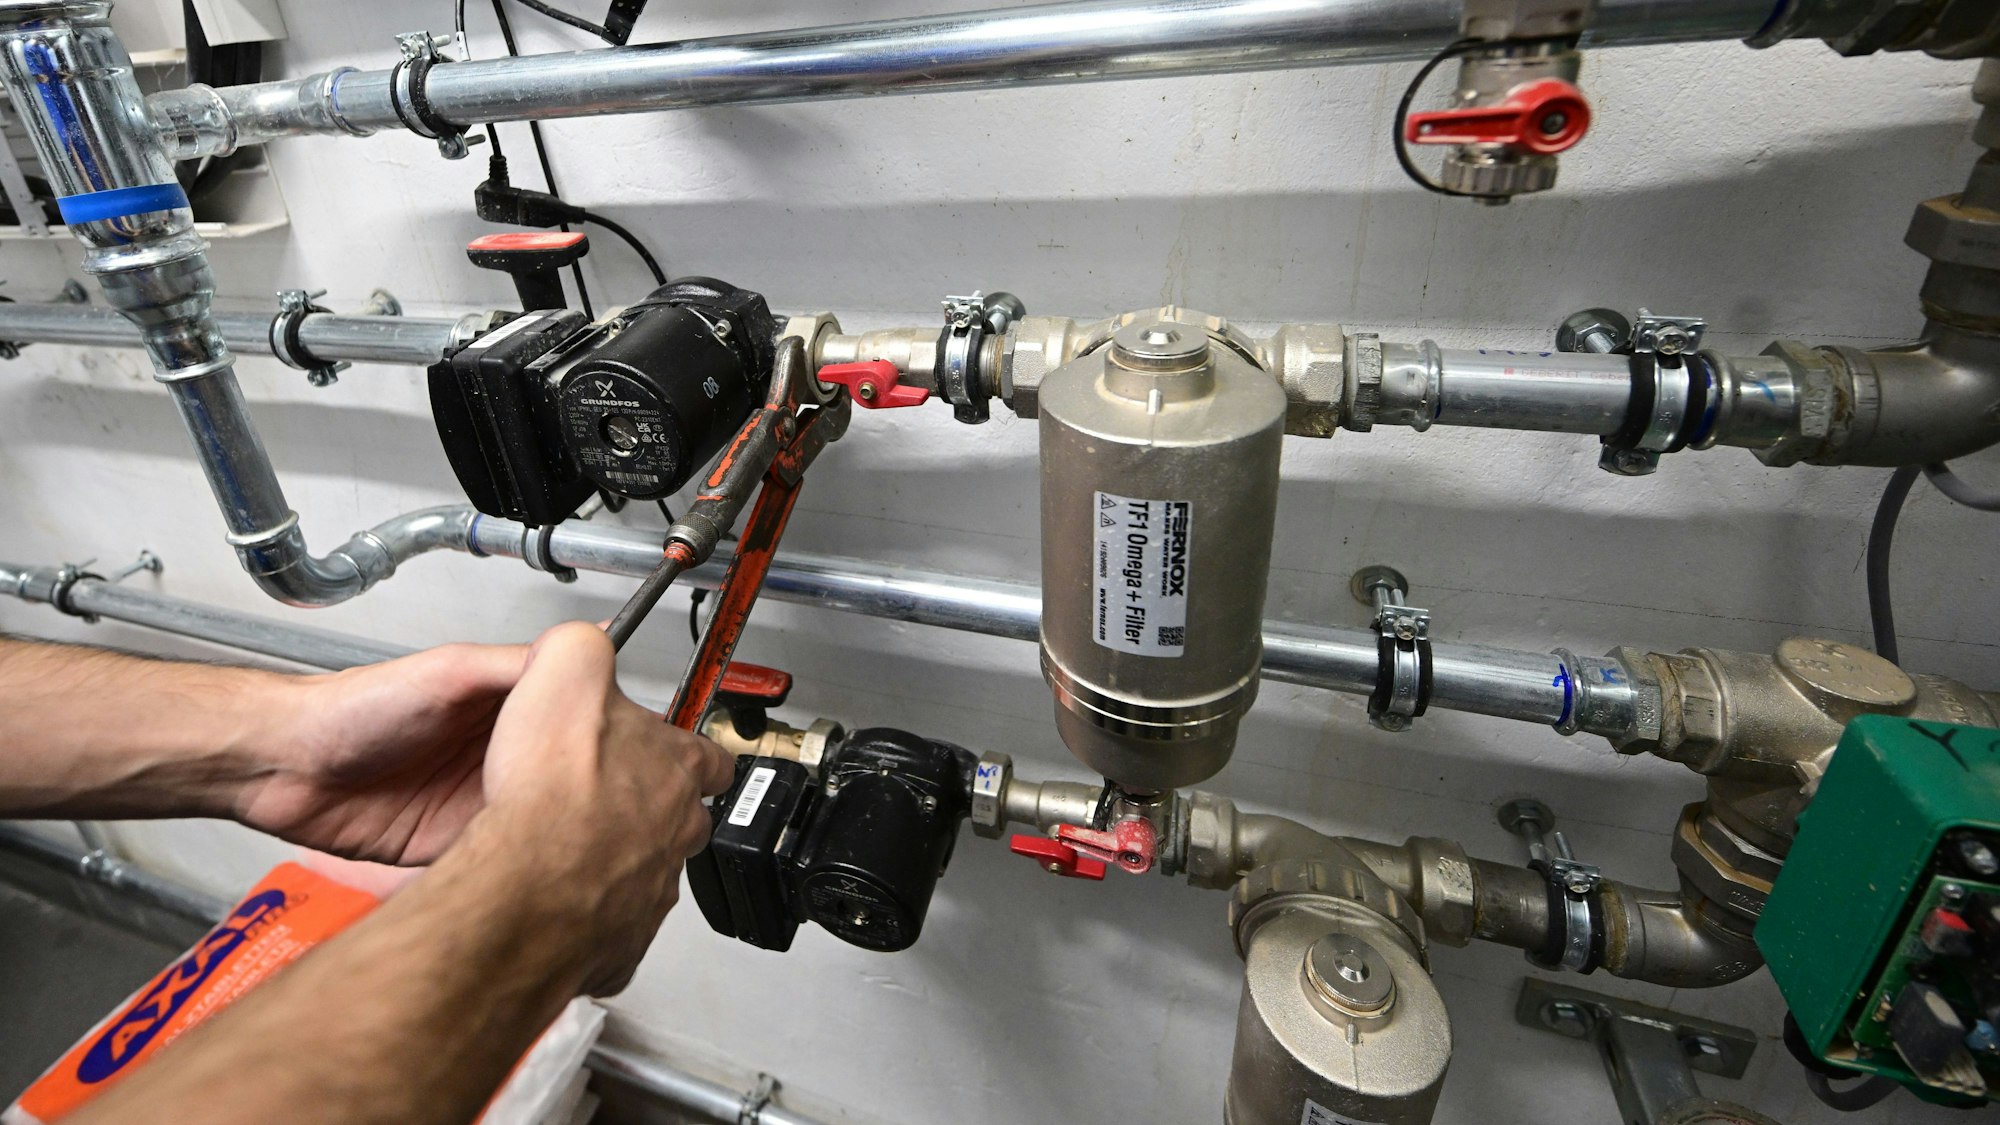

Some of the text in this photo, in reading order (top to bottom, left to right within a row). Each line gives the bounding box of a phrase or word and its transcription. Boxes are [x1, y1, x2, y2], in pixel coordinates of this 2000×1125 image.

[581, 398, 640, 408] GRUNDFOS
[652, 433, 667, 443] CE
[1128, 502, 1149, 530] TF1
[1123, 534, 1148, 588] Omega
[1162, 538, 1170, 568] WATER
[1169, 502, 1188, 597] FERNOX
[1125, 605, 1145, 645] Filter
[825, 885, 879, 902] GRUNDFOS
[111, 903, 269, 1062] AXAL
